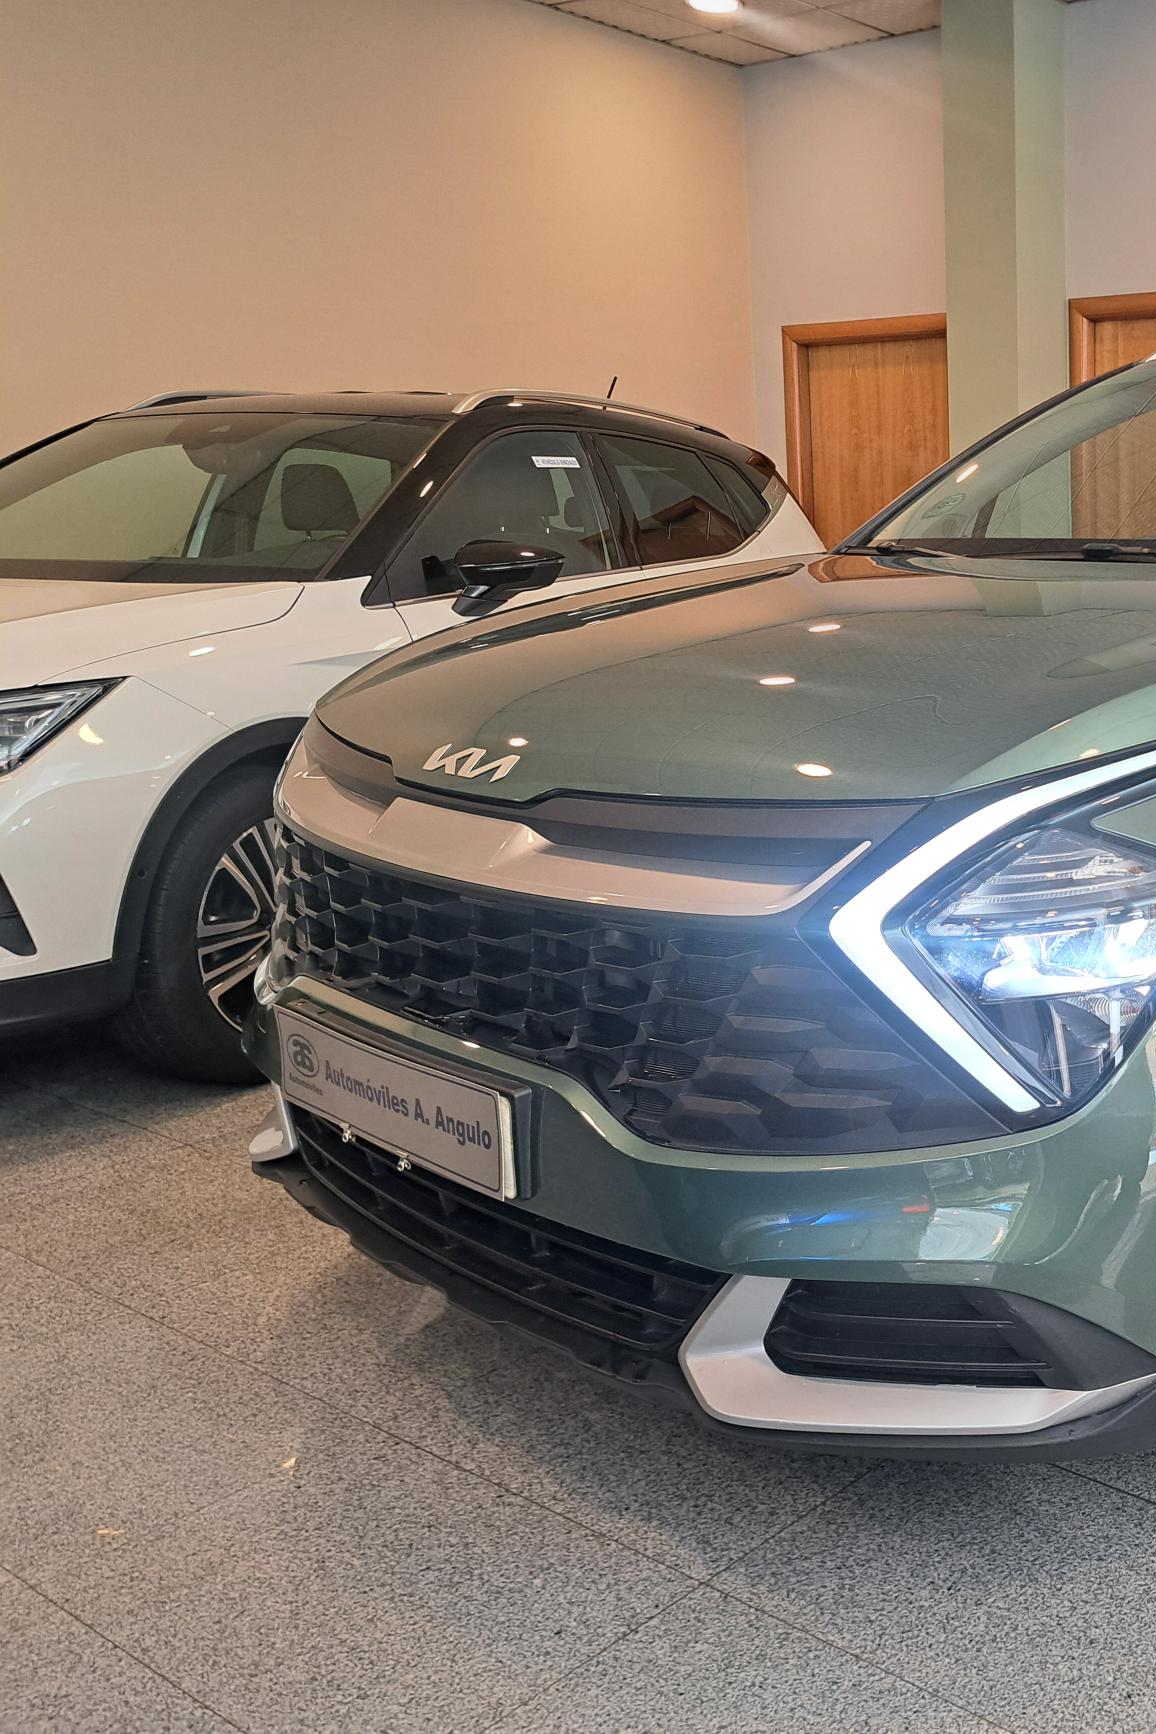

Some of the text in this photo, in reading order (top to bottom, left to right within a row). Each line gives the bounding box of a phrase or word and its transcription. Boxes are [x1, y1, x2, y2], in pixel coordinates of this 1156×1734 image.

[422, 743, 521, 783] KIA
[325, 1060, 492, 1150] Automóviles A. Angulo
